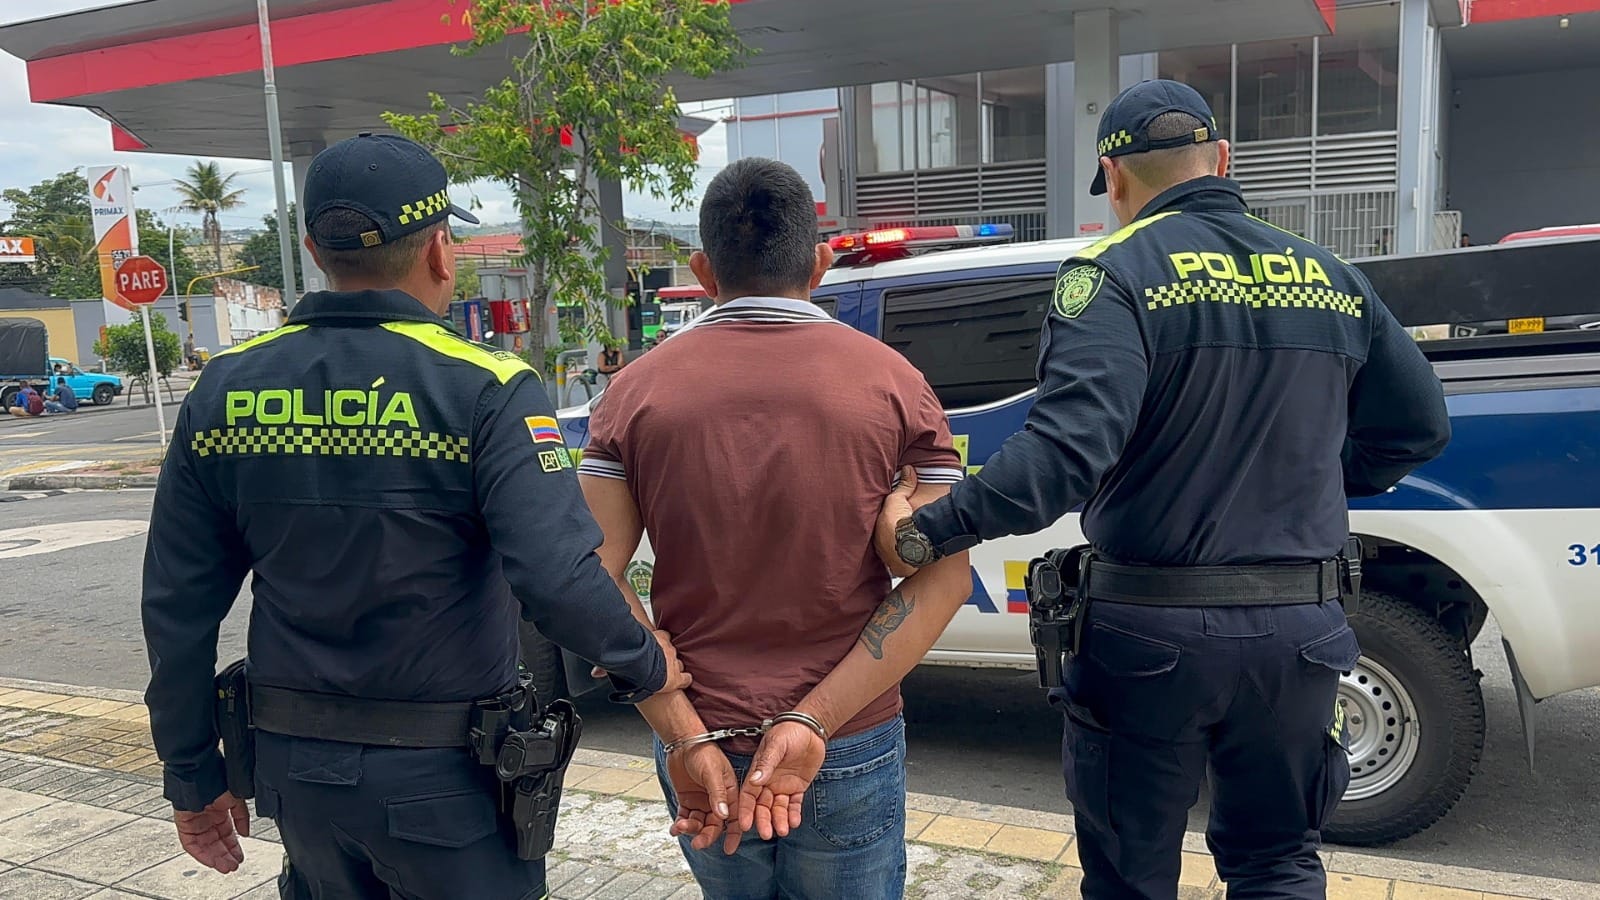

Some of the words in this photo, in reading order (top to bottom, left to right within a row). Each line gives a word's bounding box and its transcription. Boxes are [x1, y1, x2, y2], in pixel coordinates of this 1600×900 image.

[94, 207, 124, 216] PRIMAX
[1168, 246, 1332, 287] POLICÍA
[119, 270, 161, 292] PARE
[226, 376, 420, 428] POLICÍA
[1567, 543, 1600, 566] 31
